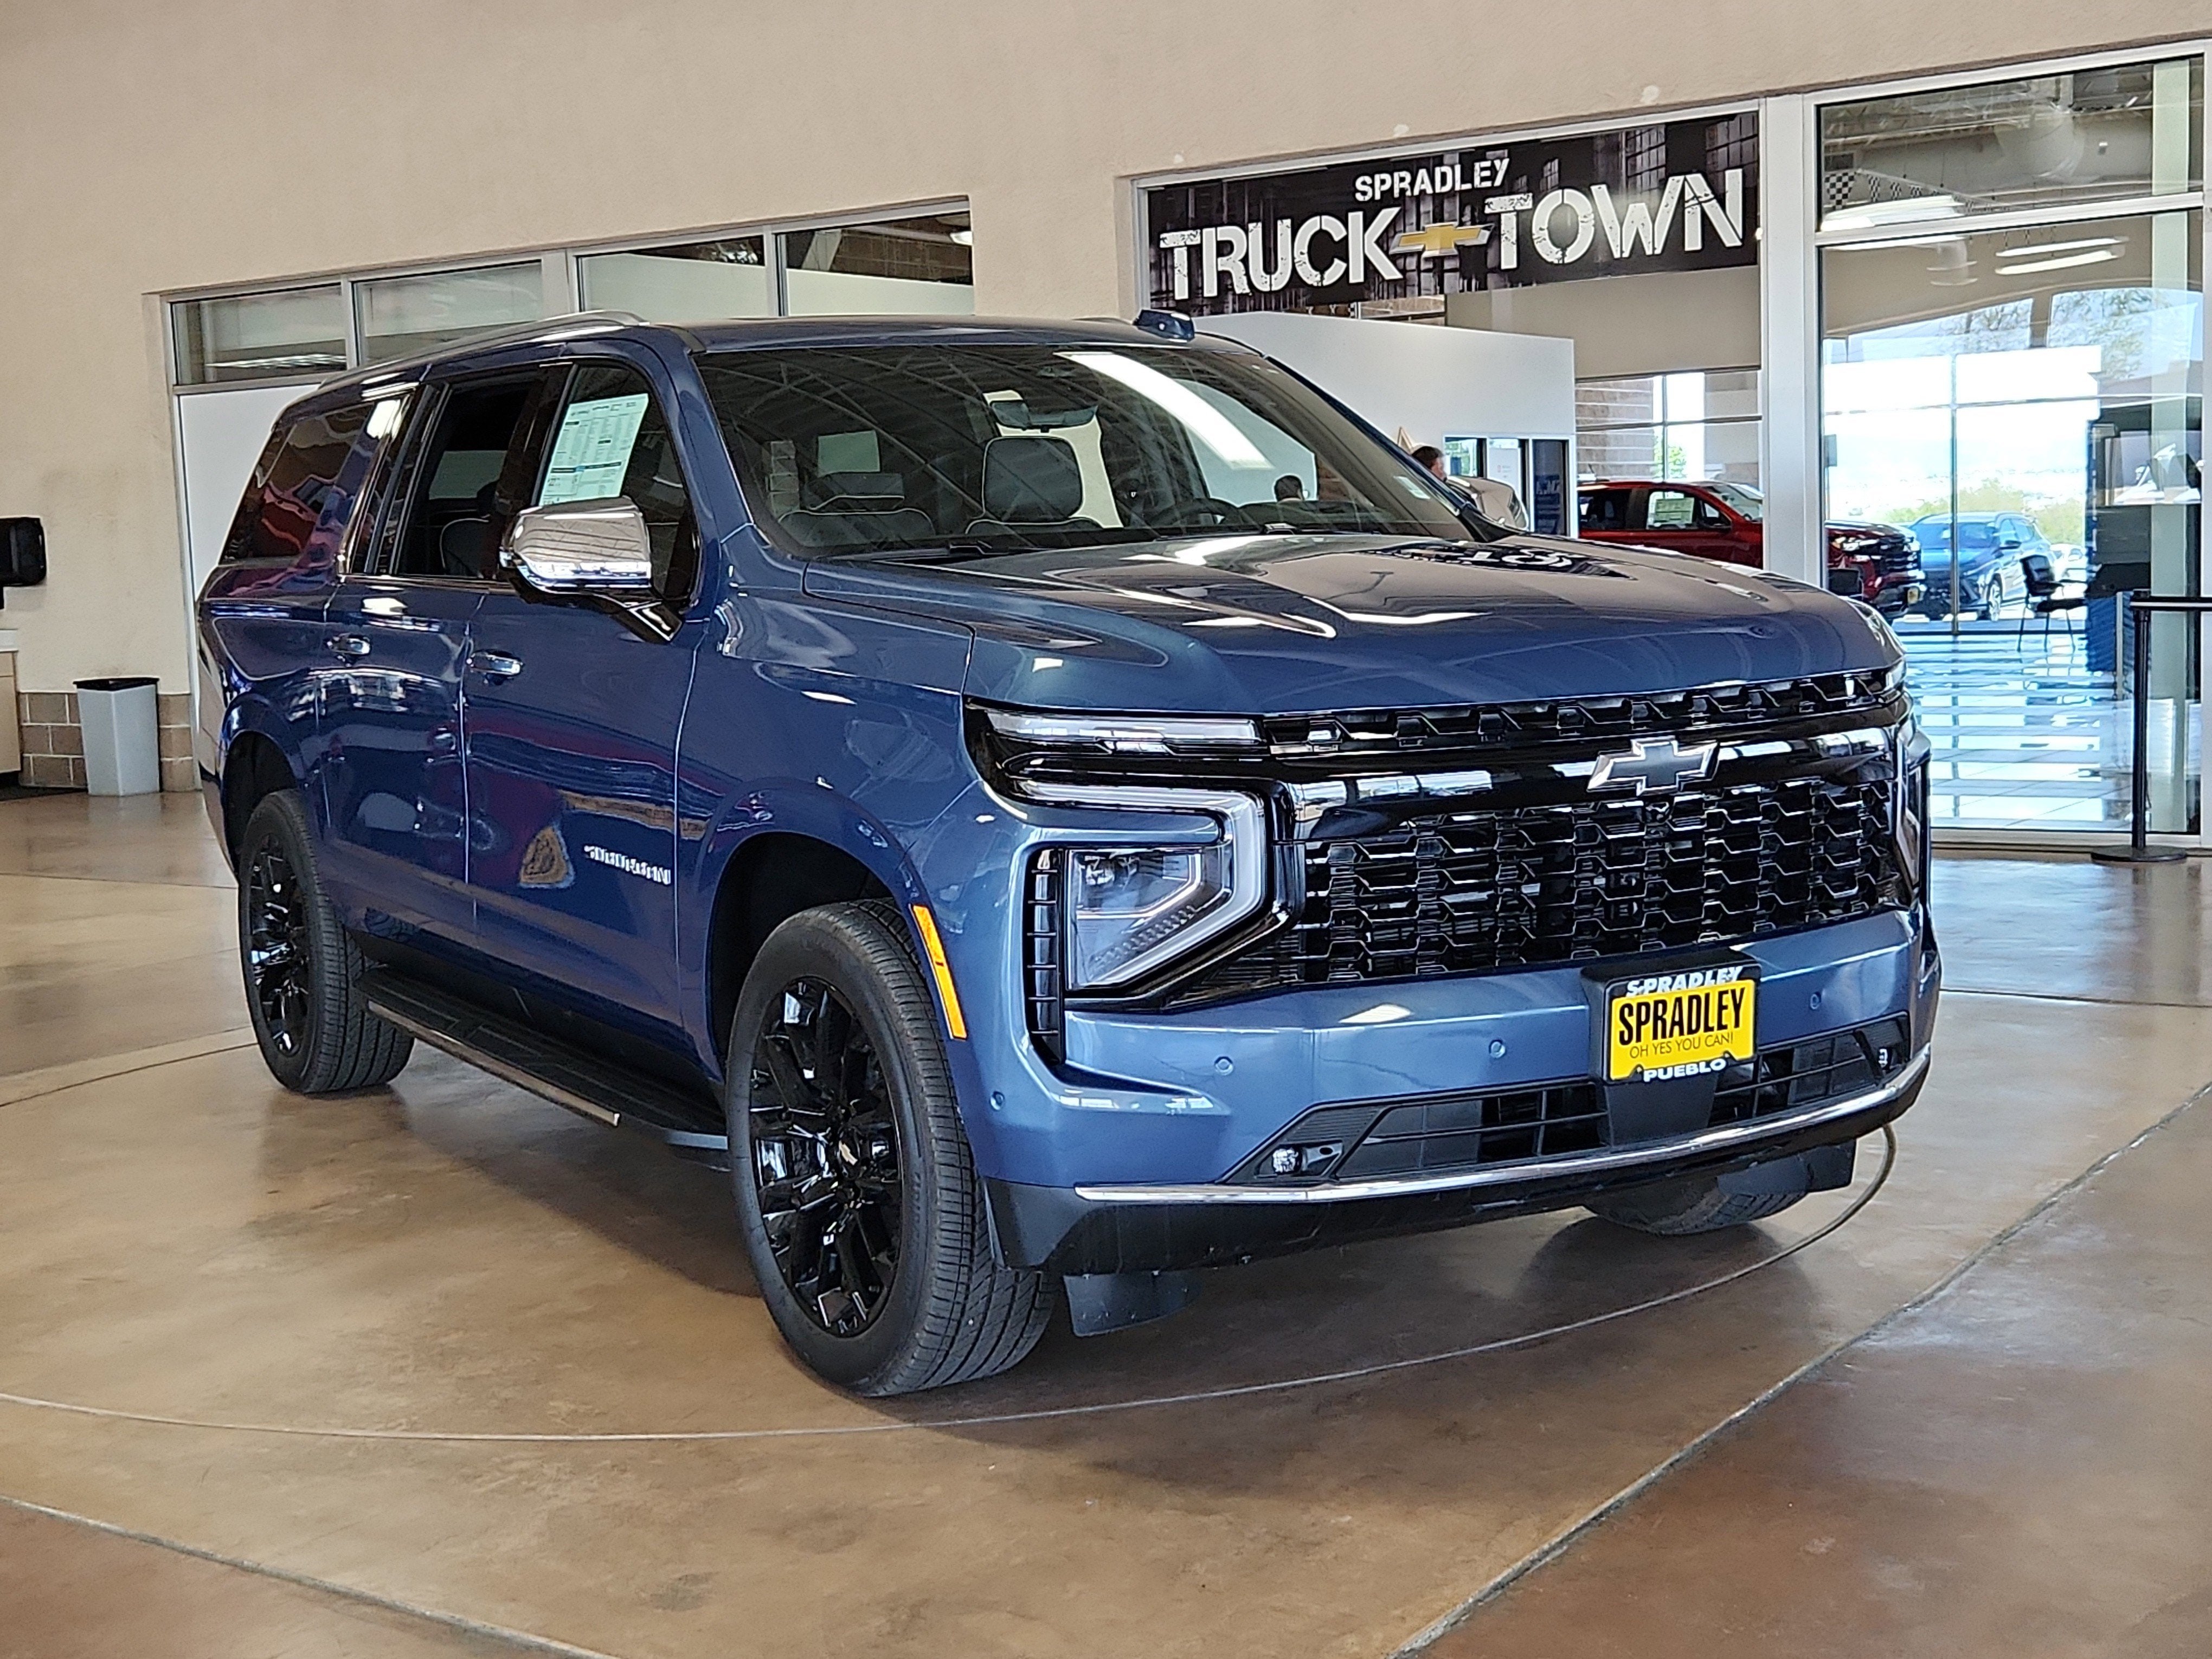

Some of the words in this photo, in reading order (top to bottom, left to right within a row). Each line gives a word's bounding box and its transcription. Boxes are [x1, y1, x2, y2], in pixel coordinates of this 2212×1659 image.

[1354, 158, 1509, 202] SPRADLEY
[1159, 207, 1403, 300] TRUCK
[1484, 168, 1742, 272] TOWN
[1626, 966, 1743, 997] SPRADLEY
[1619, 987, 1745, 1045] SPRADLEY
[1630, 1046, 1649, 1059] OH
[1652, 1042, 1672, 1055] YES
[1675, 1037, 1701, 1052] YOU
[1705, 1032, 1734, 1049] CAN!
[1644, 1058, 1726, 1082] PUEBLO
